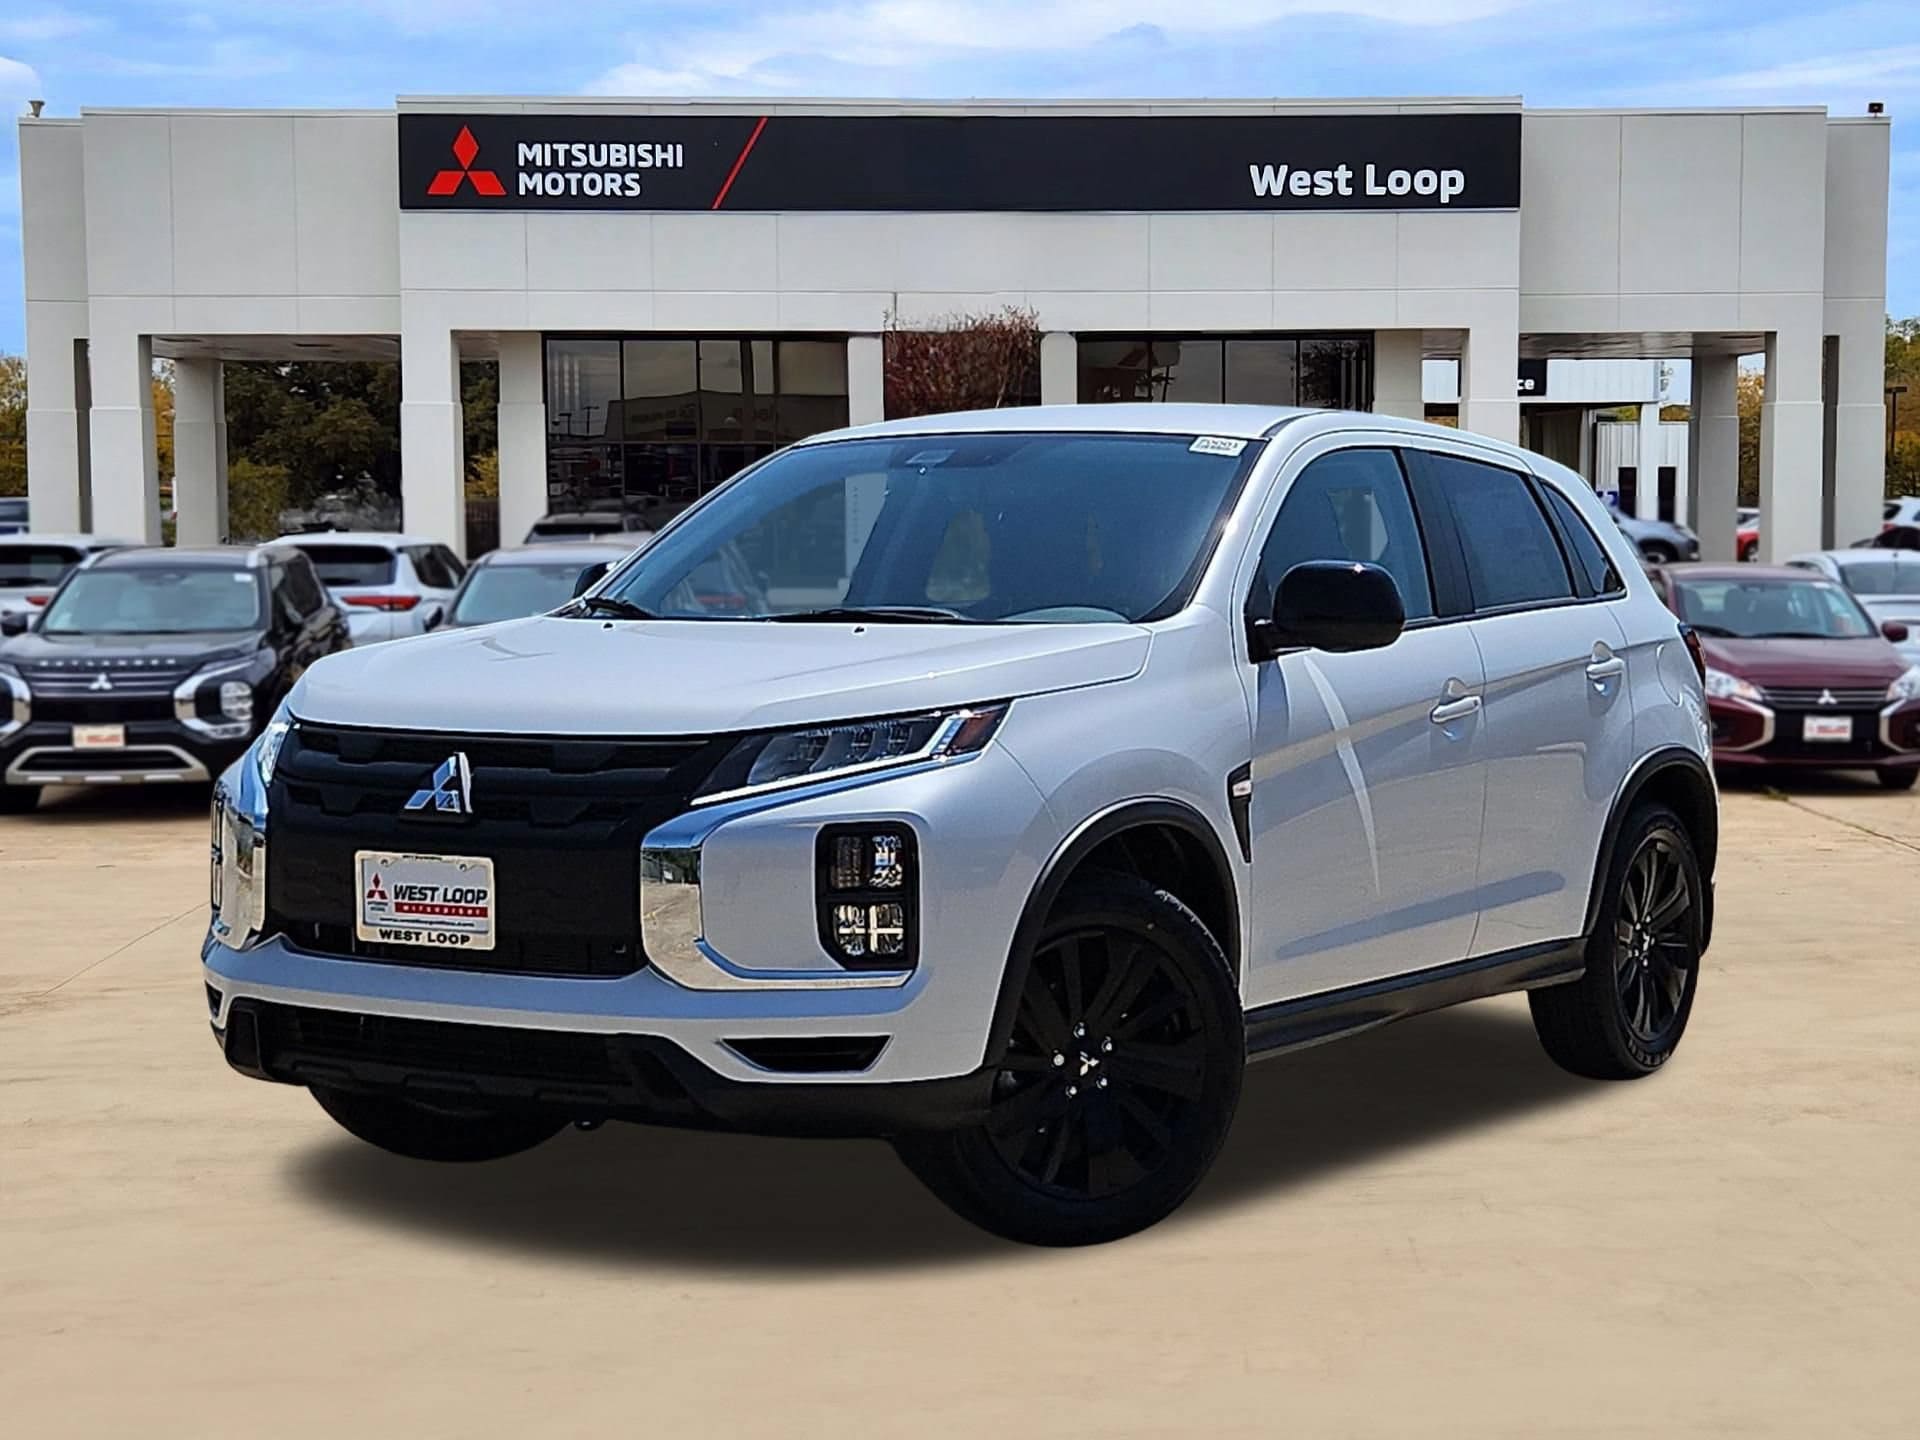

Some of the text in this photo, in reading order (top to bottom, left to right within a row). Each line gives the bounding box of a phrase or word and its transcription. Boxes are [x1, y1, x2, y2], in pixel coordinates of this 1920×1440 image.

[518, 142, 684, 168] MITSUBISHI
[518, 172, 641, 197] MOTORS
[1249, 163, 1466, 204] West Loop
[393, 884, 489, 905] WEST LOOP
[378, 928, 471, 945] WEST LOOP
